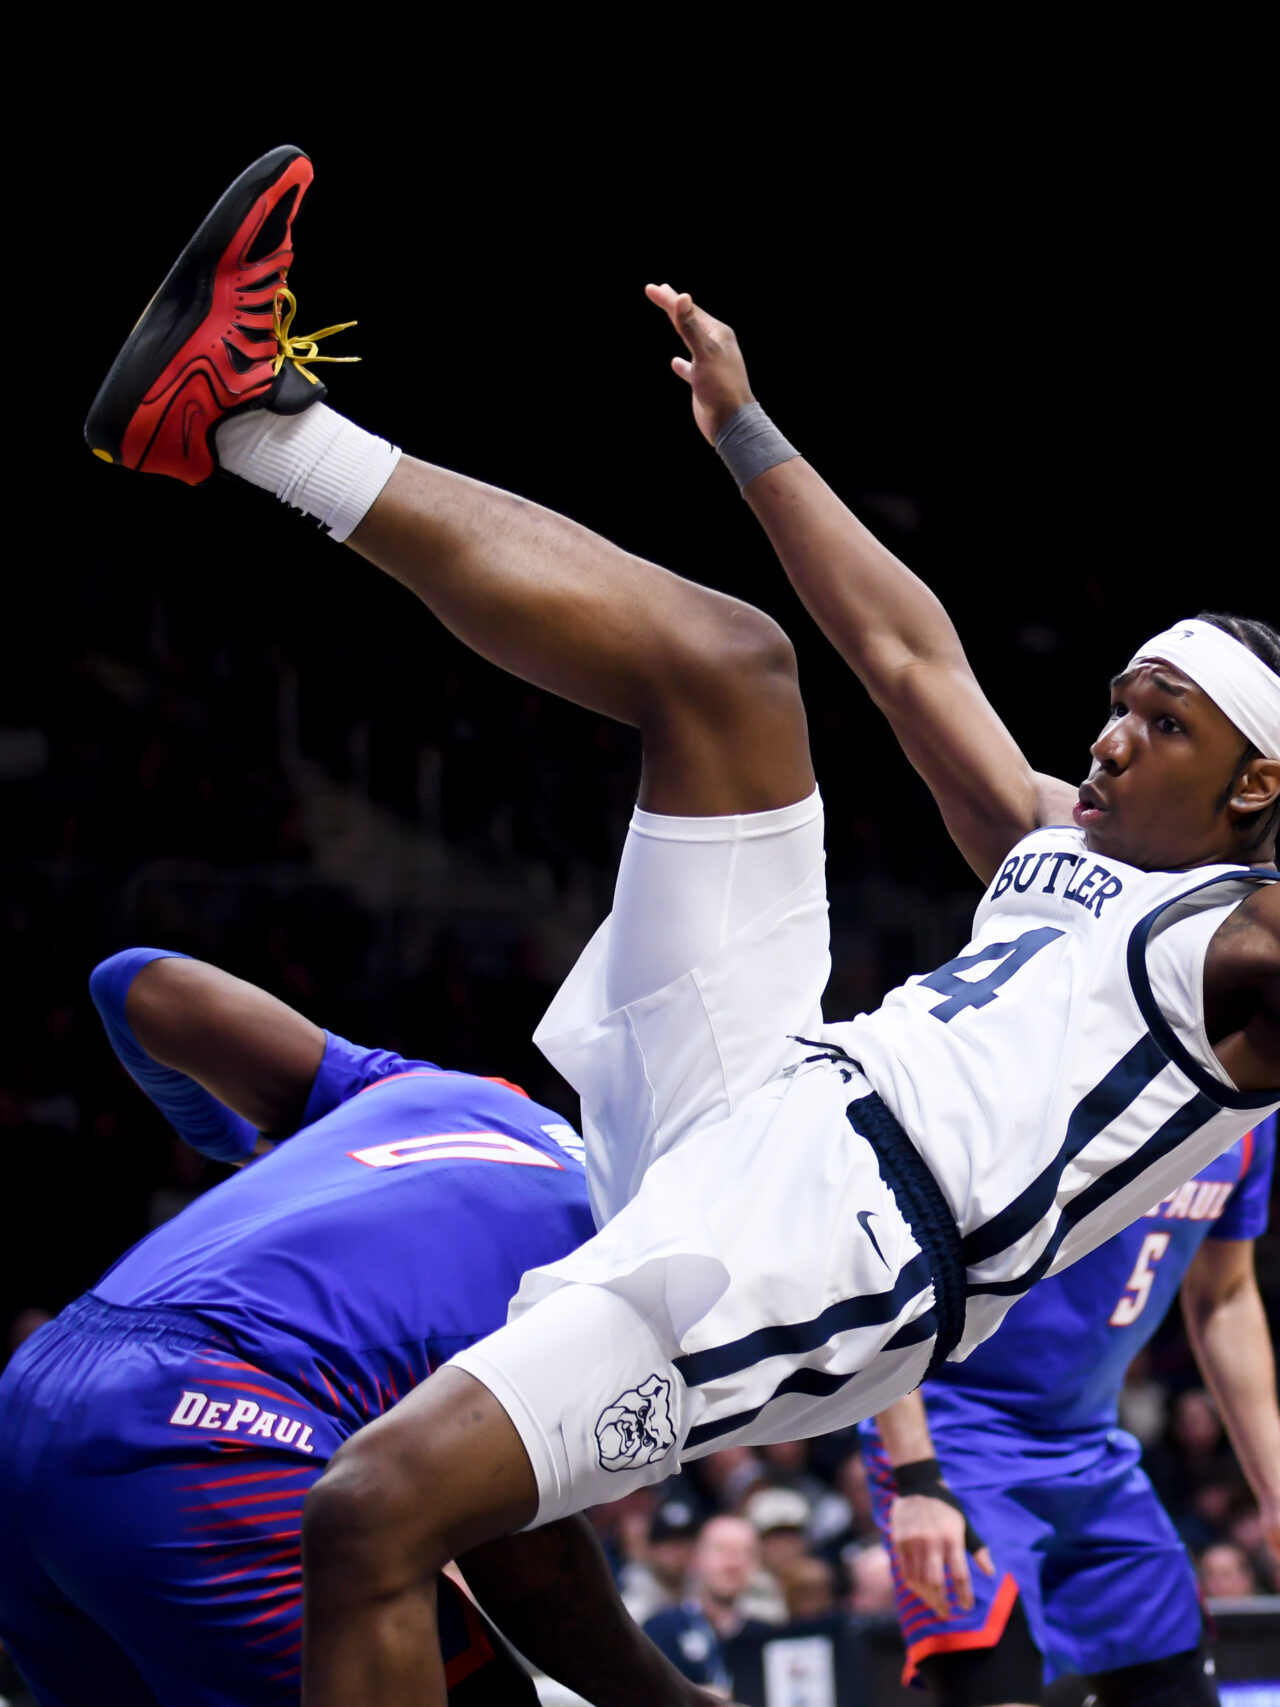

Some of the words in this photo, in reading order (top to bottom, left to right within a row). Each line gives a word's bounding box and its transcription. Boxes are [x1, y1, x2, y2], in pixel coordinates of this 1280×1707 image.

[991, 852, 1123, 919] BUTLER
[916, 926, 1067, 1024] 4
[1108, 1231, 1172, 1327] 5
[169, 1391, 314, 1453] DEPAUL
